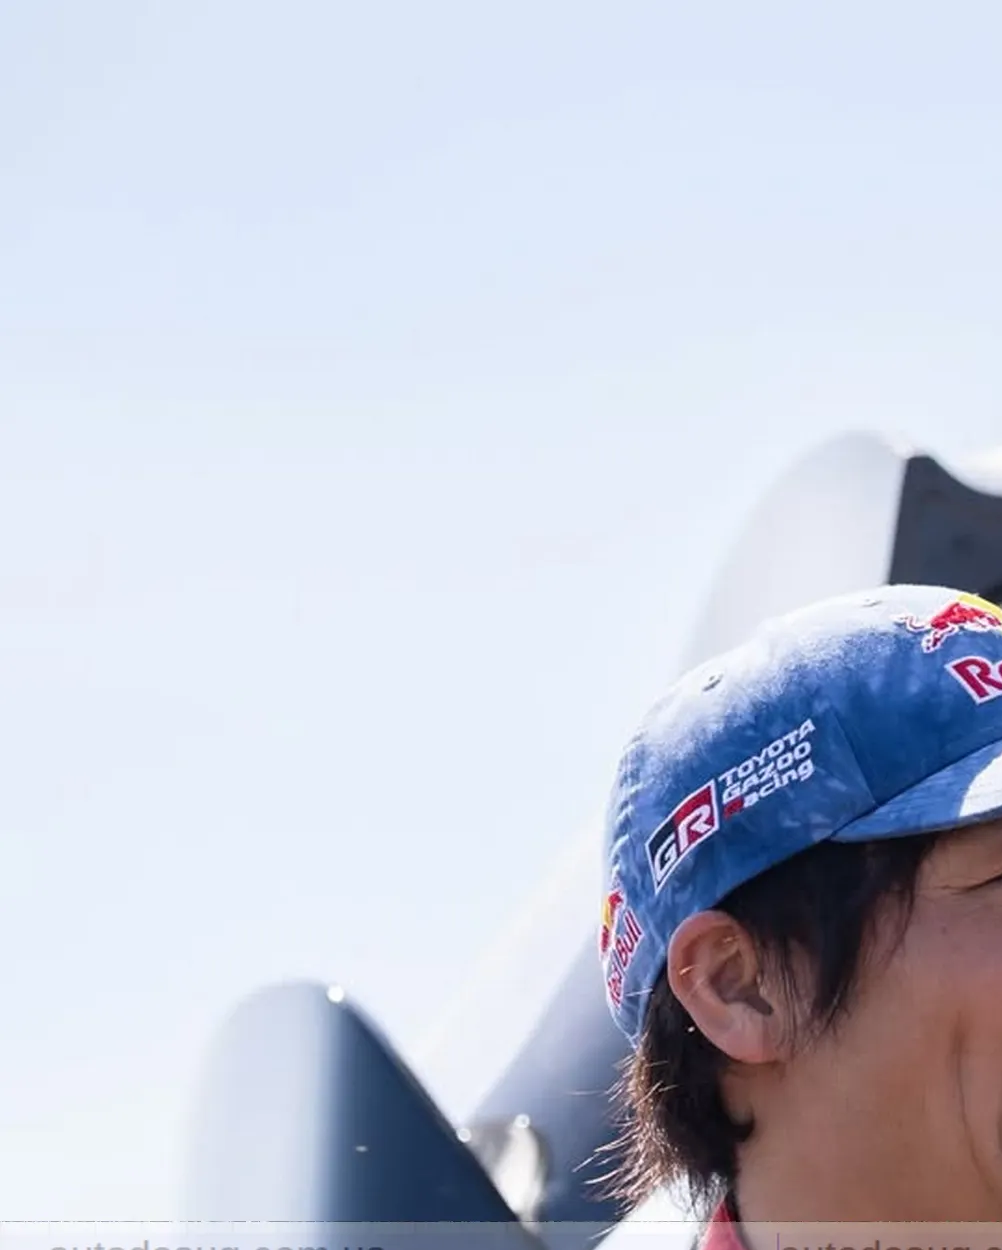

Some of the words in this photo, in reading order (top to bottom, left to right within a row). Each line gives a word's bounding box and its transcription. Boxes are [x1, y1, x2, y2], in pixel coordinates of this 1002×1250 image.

[718, 718, 815, 786] TOYOTA
[722, 741, 811, 804] GAZOO
[723, 759, 814, 821] Racing
[654, 803, 713, 882] GR
[615, 908, 642, 968] Bull
